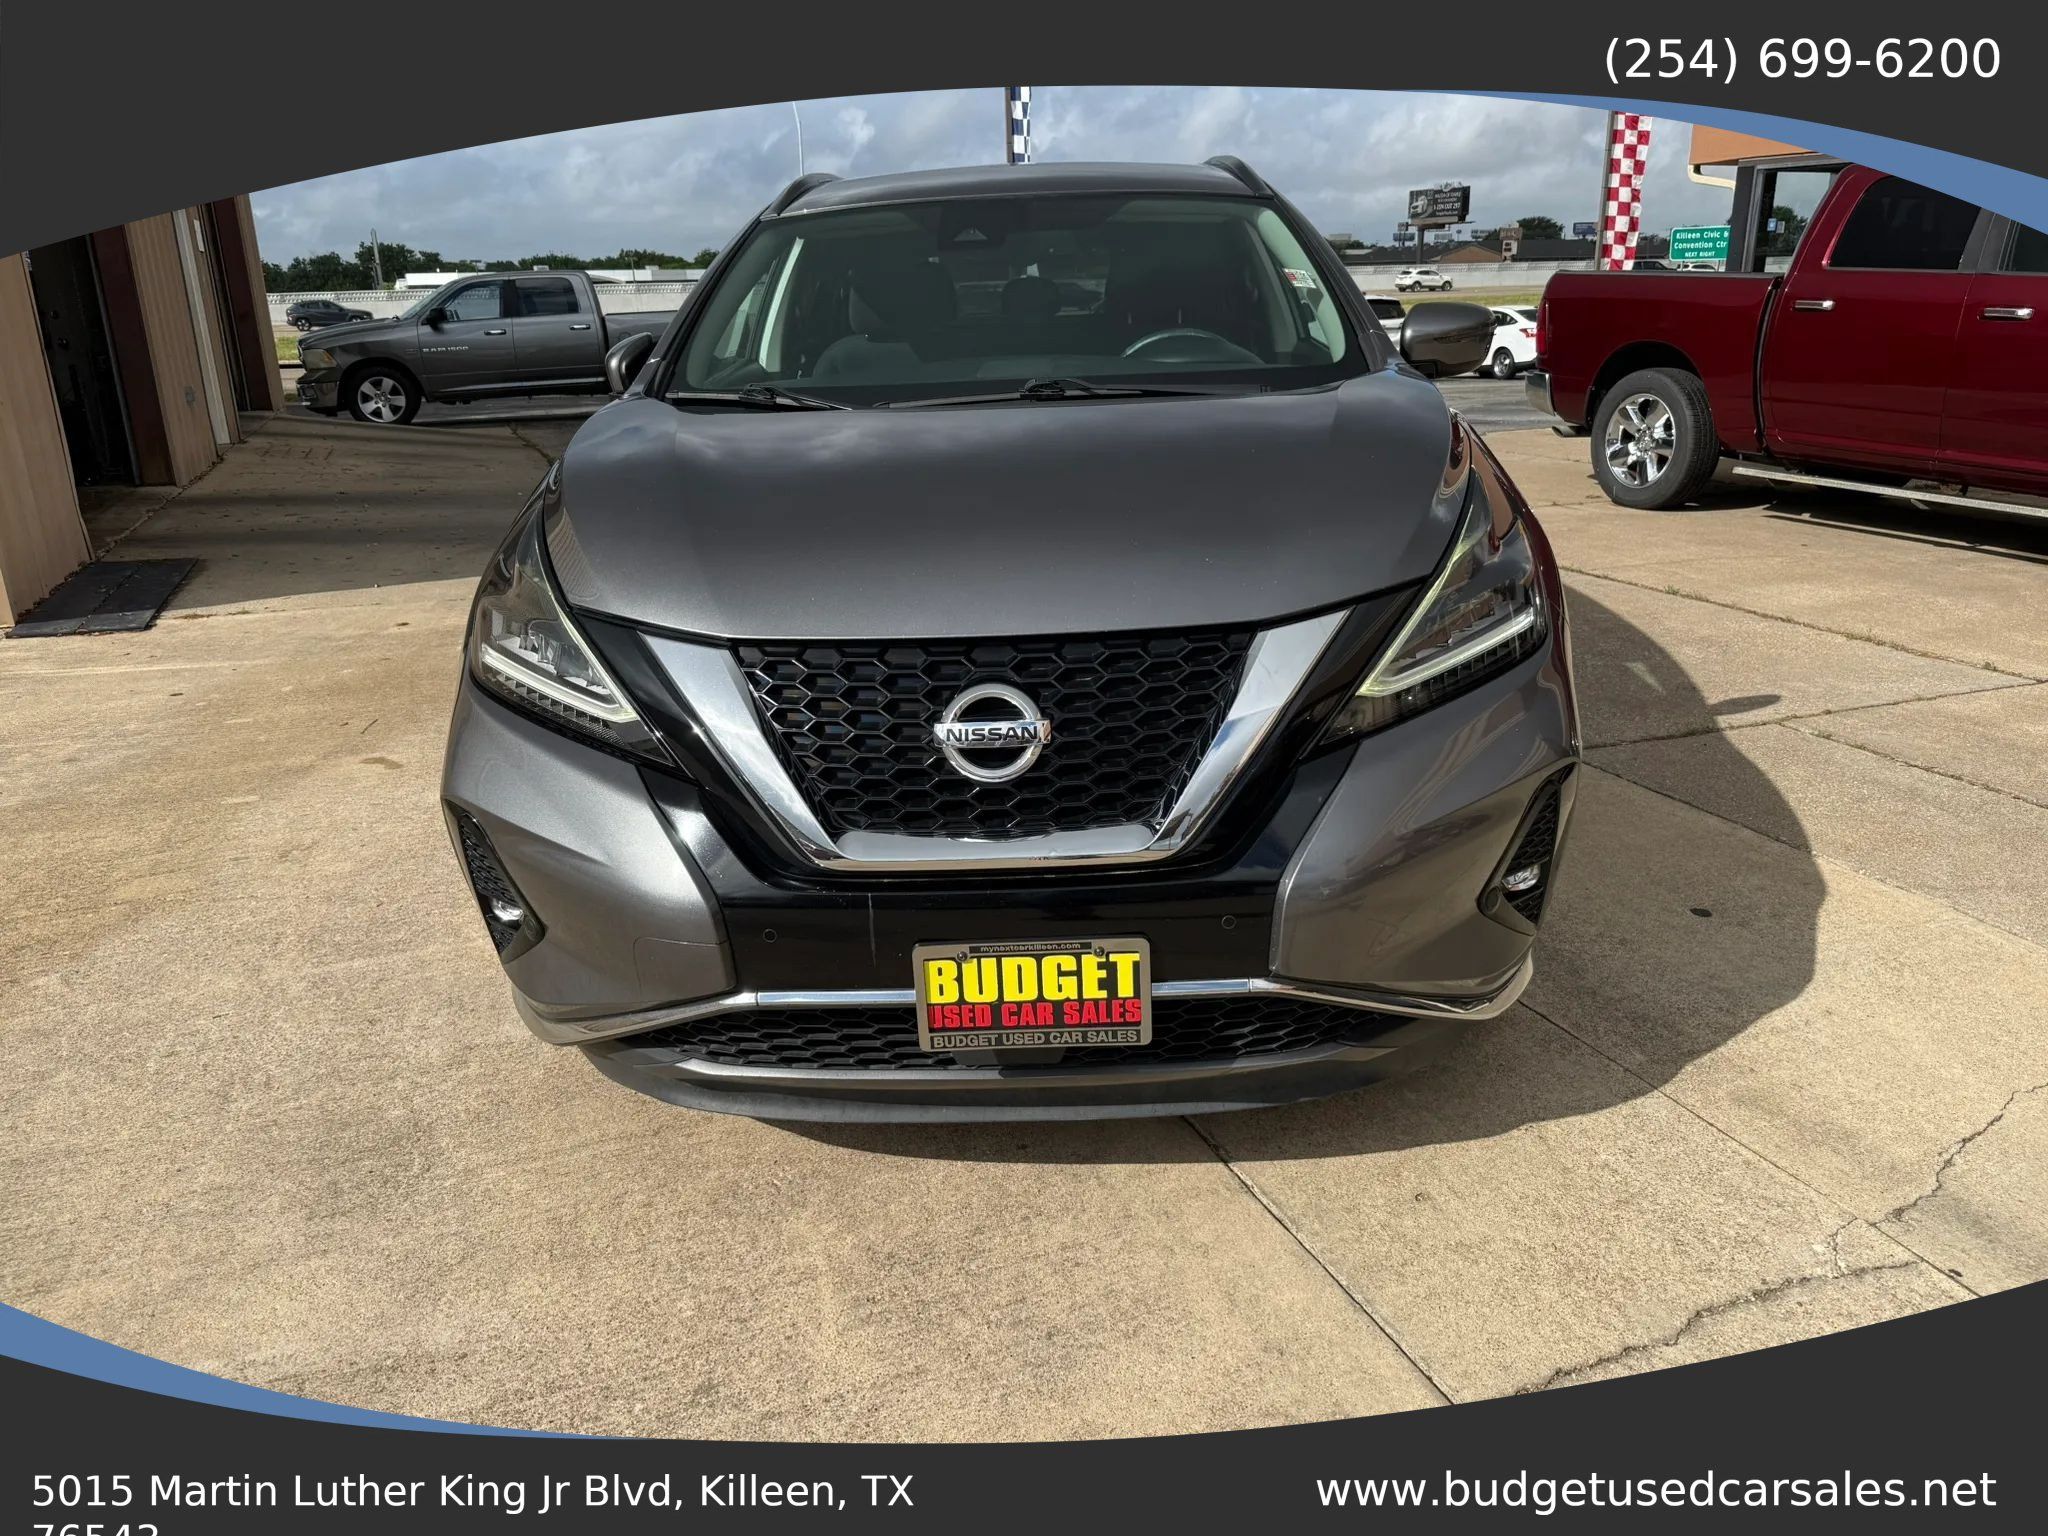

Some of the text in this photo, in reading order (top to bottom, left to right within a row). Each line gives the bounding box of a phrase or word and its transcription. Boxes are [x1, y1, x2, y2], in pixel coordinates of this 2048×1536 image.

[1674, 241, 1713, 249] Convention
[946, 726, 1038, 742] NISSAN
[980, 942, 1081, 953] mynextcarkilleen.com
[924, 952, 1141, 1005] BUDGET
[928, 999, 1142, 1029] USED CAR SALES
[933, 1030, 1138, 1049] BUDGET USED CAR SALES
